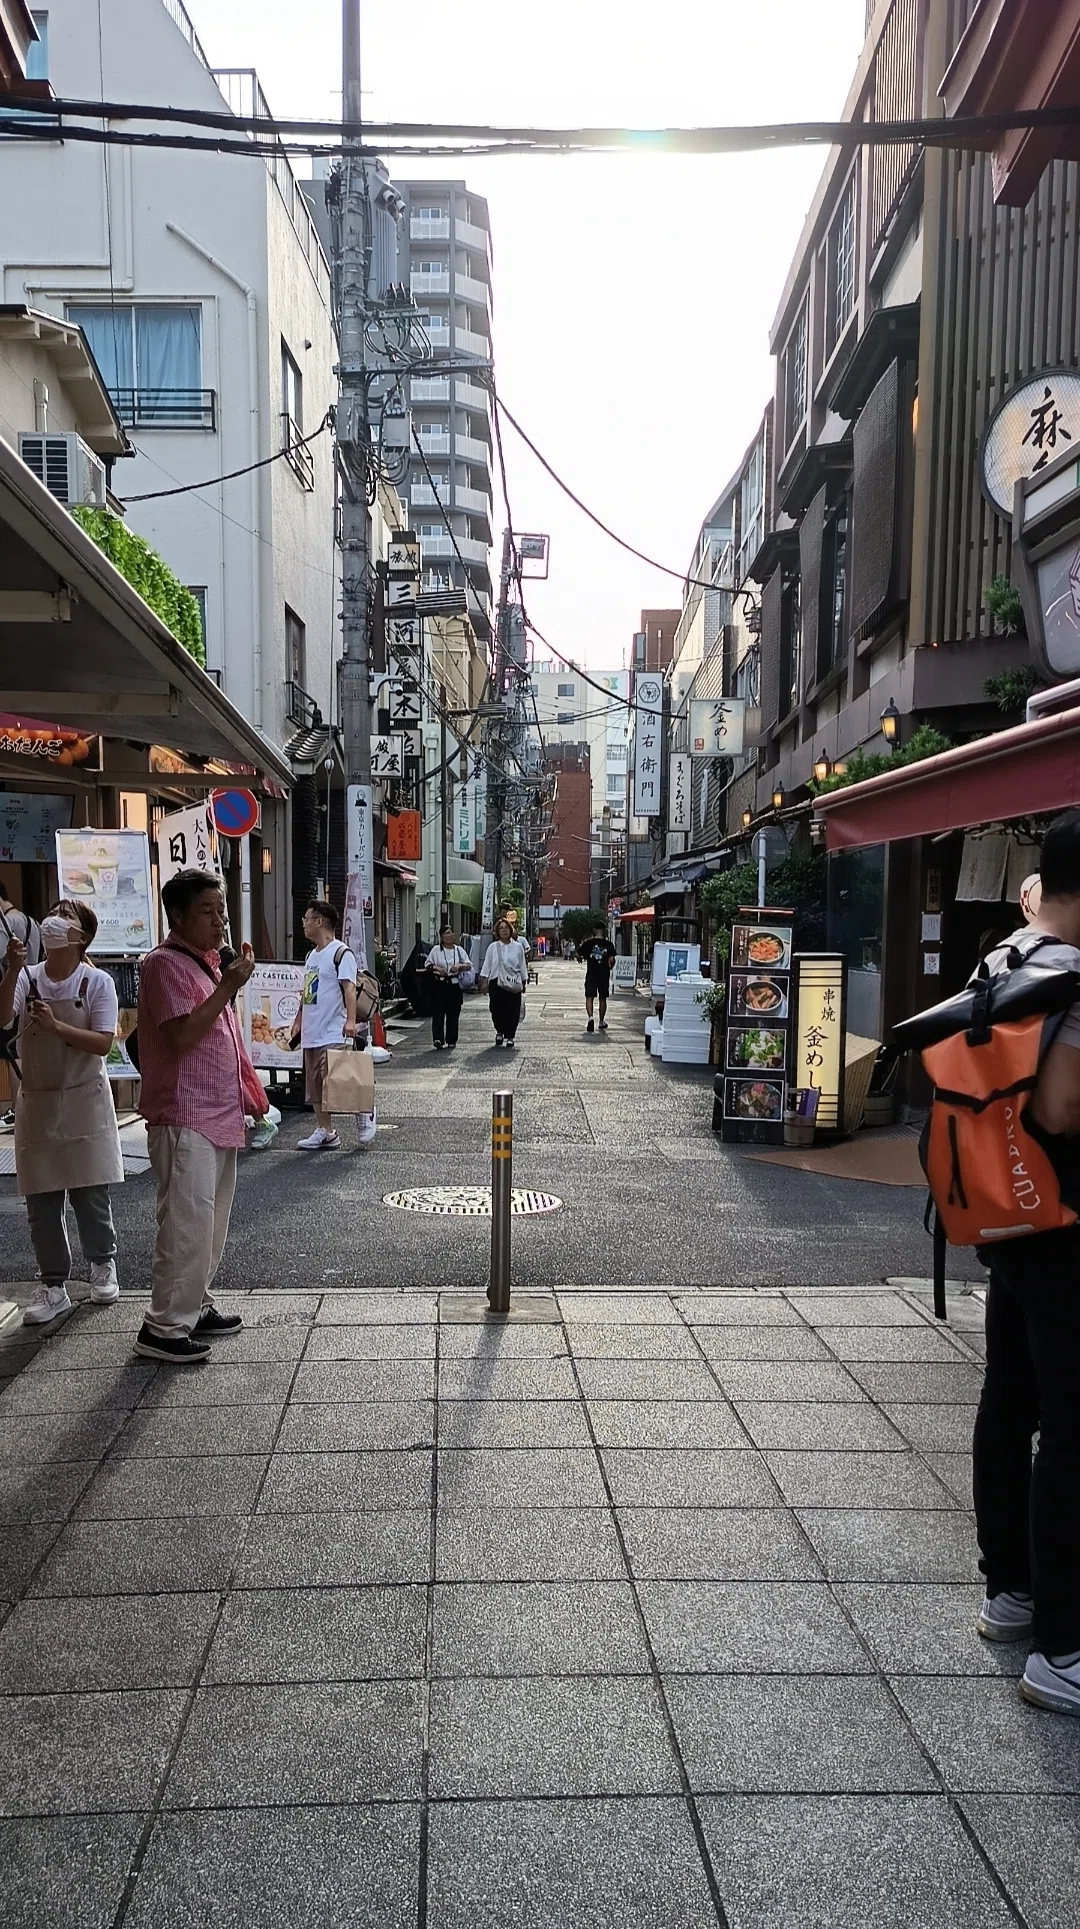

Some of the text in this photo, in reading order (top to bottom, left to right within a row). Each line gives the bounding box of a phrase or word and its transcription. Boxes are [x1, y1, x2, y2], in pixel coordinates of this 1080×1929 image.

[1022, 386, 1071, 471] 麻
[709, 702, 732, 751] 釜めし
[357, 808, 367, 859] 東京カレーパン
[262, 972, 299, 981] CASTELLA
[821, 988, 836, 1022] 串焼
[803, 1025, 829, 1089] 釜めし
